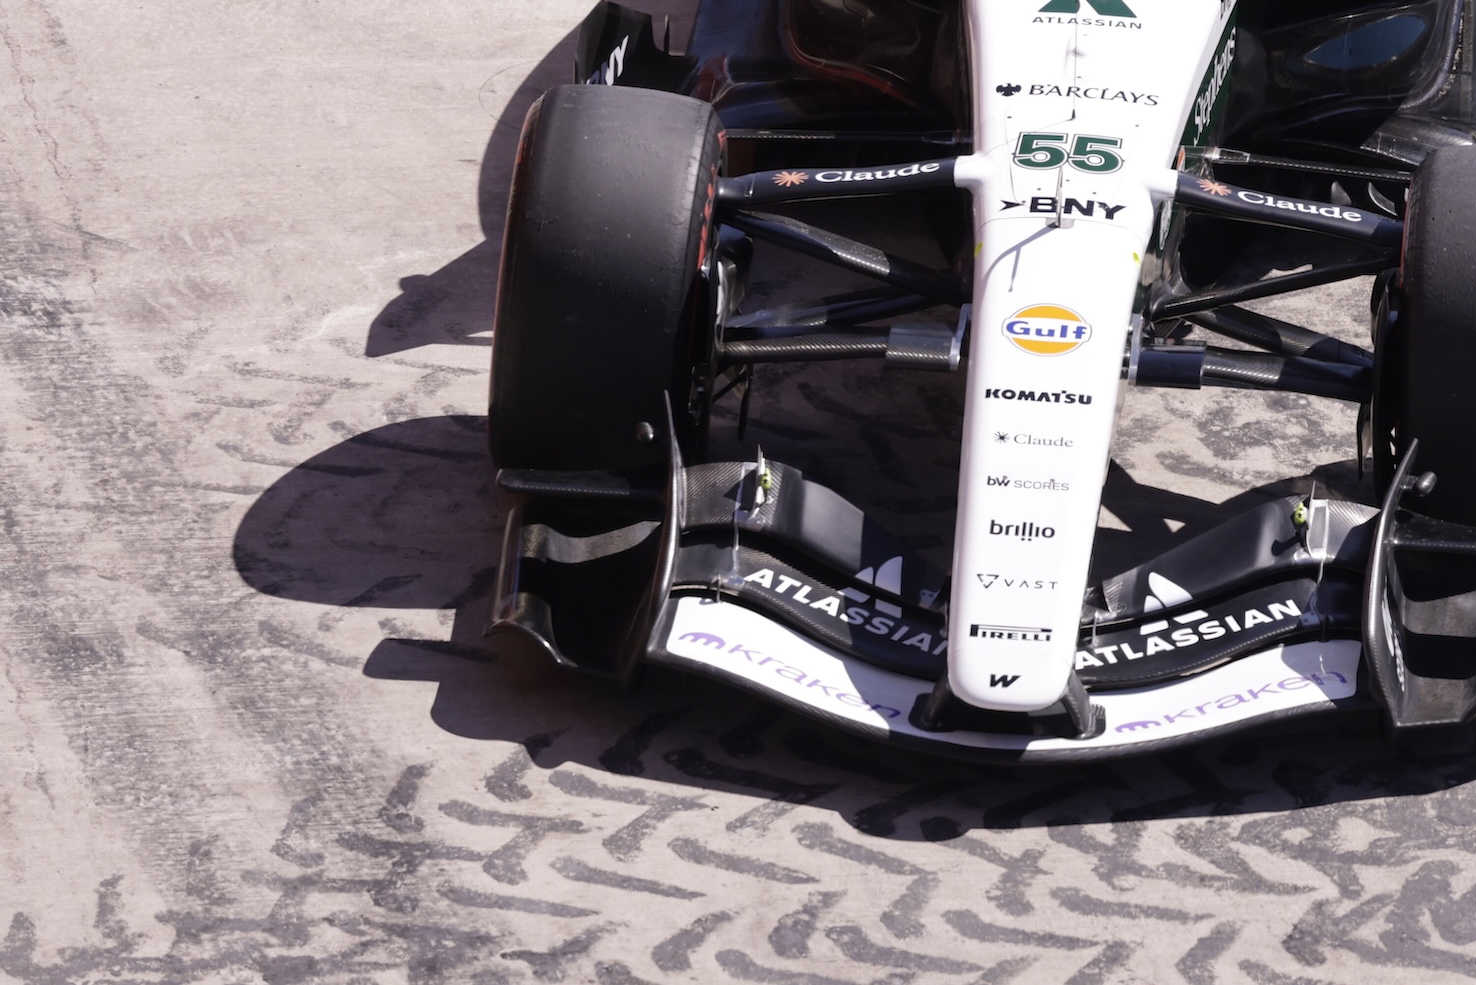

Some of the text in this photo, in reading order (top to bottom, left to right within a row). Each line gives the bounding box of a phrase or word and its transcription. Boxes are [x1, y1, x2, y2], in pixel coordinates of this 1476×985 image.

[1032, 16, 1143, 30] ATLASSIAN
[1028, 84, 1160, 107] BARCLAYS
[1012, 131, 1124, 174] 55
[814, 162, 940, 183] Claude
[1029, 196, 1127, 220] BNY
[1236, 189, 1363, 222] Claude
[1005, 320, 1088, 341] Gulf
[984, 388, 1093, 405] KOMATSU
[1013, 433, 1074, 448] Claude
[1013, 478, 1070, 491] SCORES
[1004, 578, 1059, 591] VAST
[969, 624, 1053, 642] PIRELLI
[1075, 599, 1302, 670] ATLASSIAN
[728, 643, 902, 719] kraken
[1163, 670, 1349, 723] kraken
